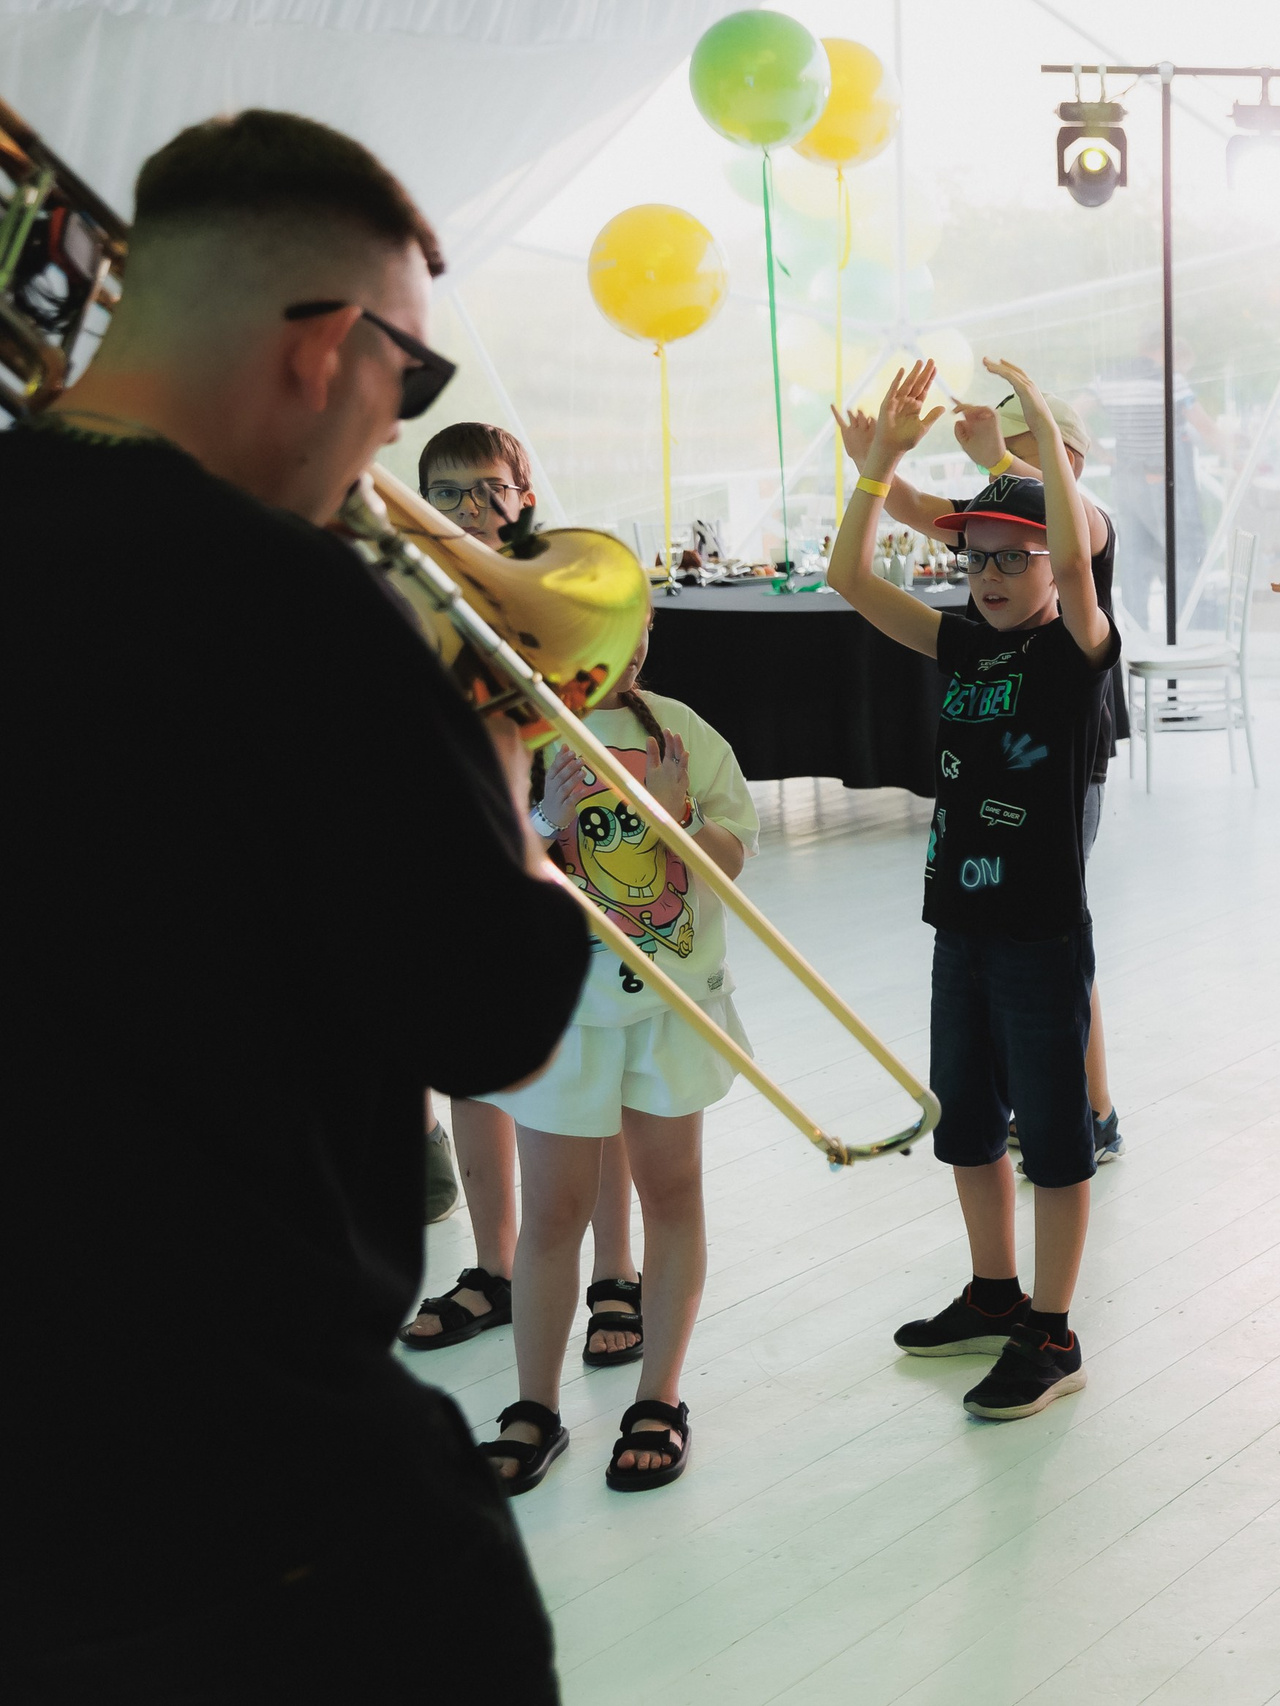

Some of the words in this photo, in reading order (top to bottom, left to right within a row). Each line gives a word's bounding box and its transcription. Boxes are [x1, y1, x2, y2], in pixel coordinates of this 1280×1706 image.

[985, 805, 1002, 815] GAME
[1002, 810, 1021, 820] OVER
[962, 857, 1000, 888] ON
